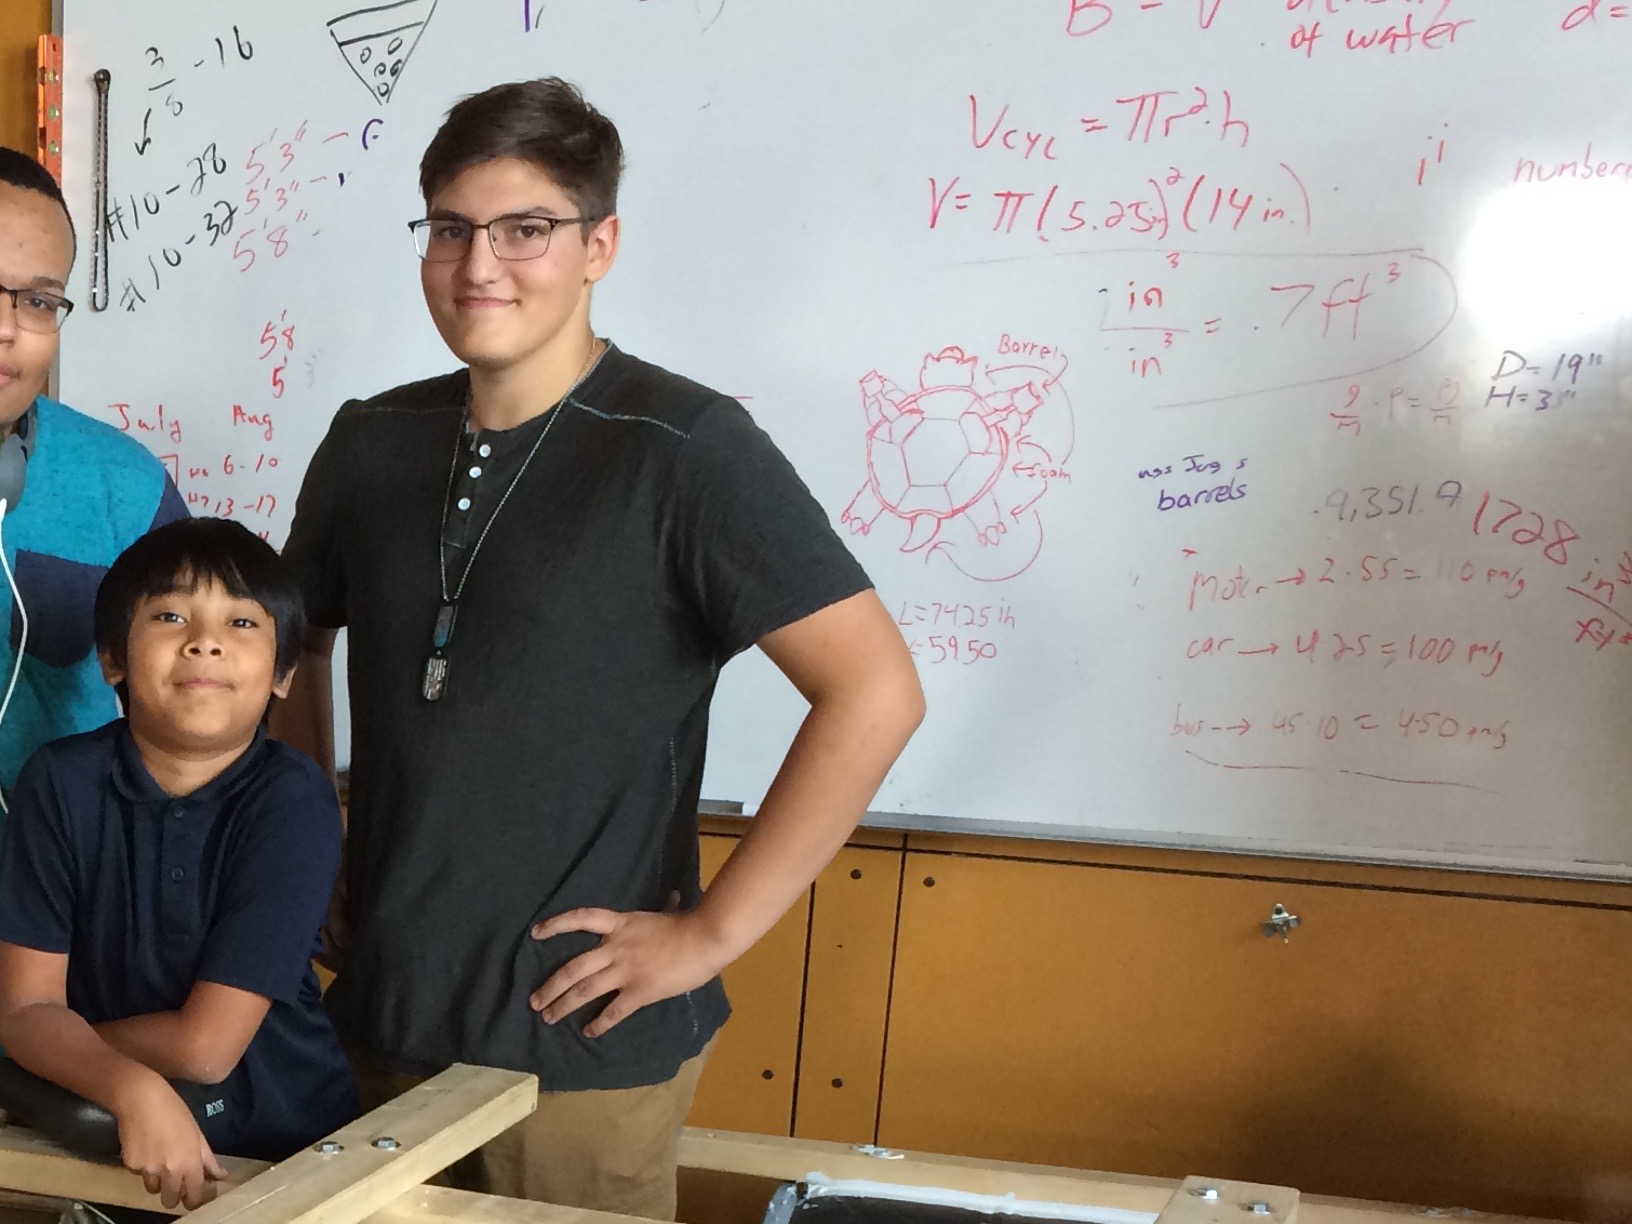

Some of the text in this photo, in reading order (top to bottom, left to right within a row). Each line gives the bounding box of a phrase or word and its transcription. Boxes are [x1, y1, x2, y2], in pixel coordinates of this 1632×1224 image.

[1290, 21, 1322, 58] of
[1346, 14, 1475, 54] water
[108, 403, 182, 444] July
[232, 404, 274, 442] Aug
[1157, 477, 1248, 512] barrels
[1473, 490, 1582, 566] 1728
[1186, 638, 1234, 660] car
[1408, 634, 1456, 664] 100
